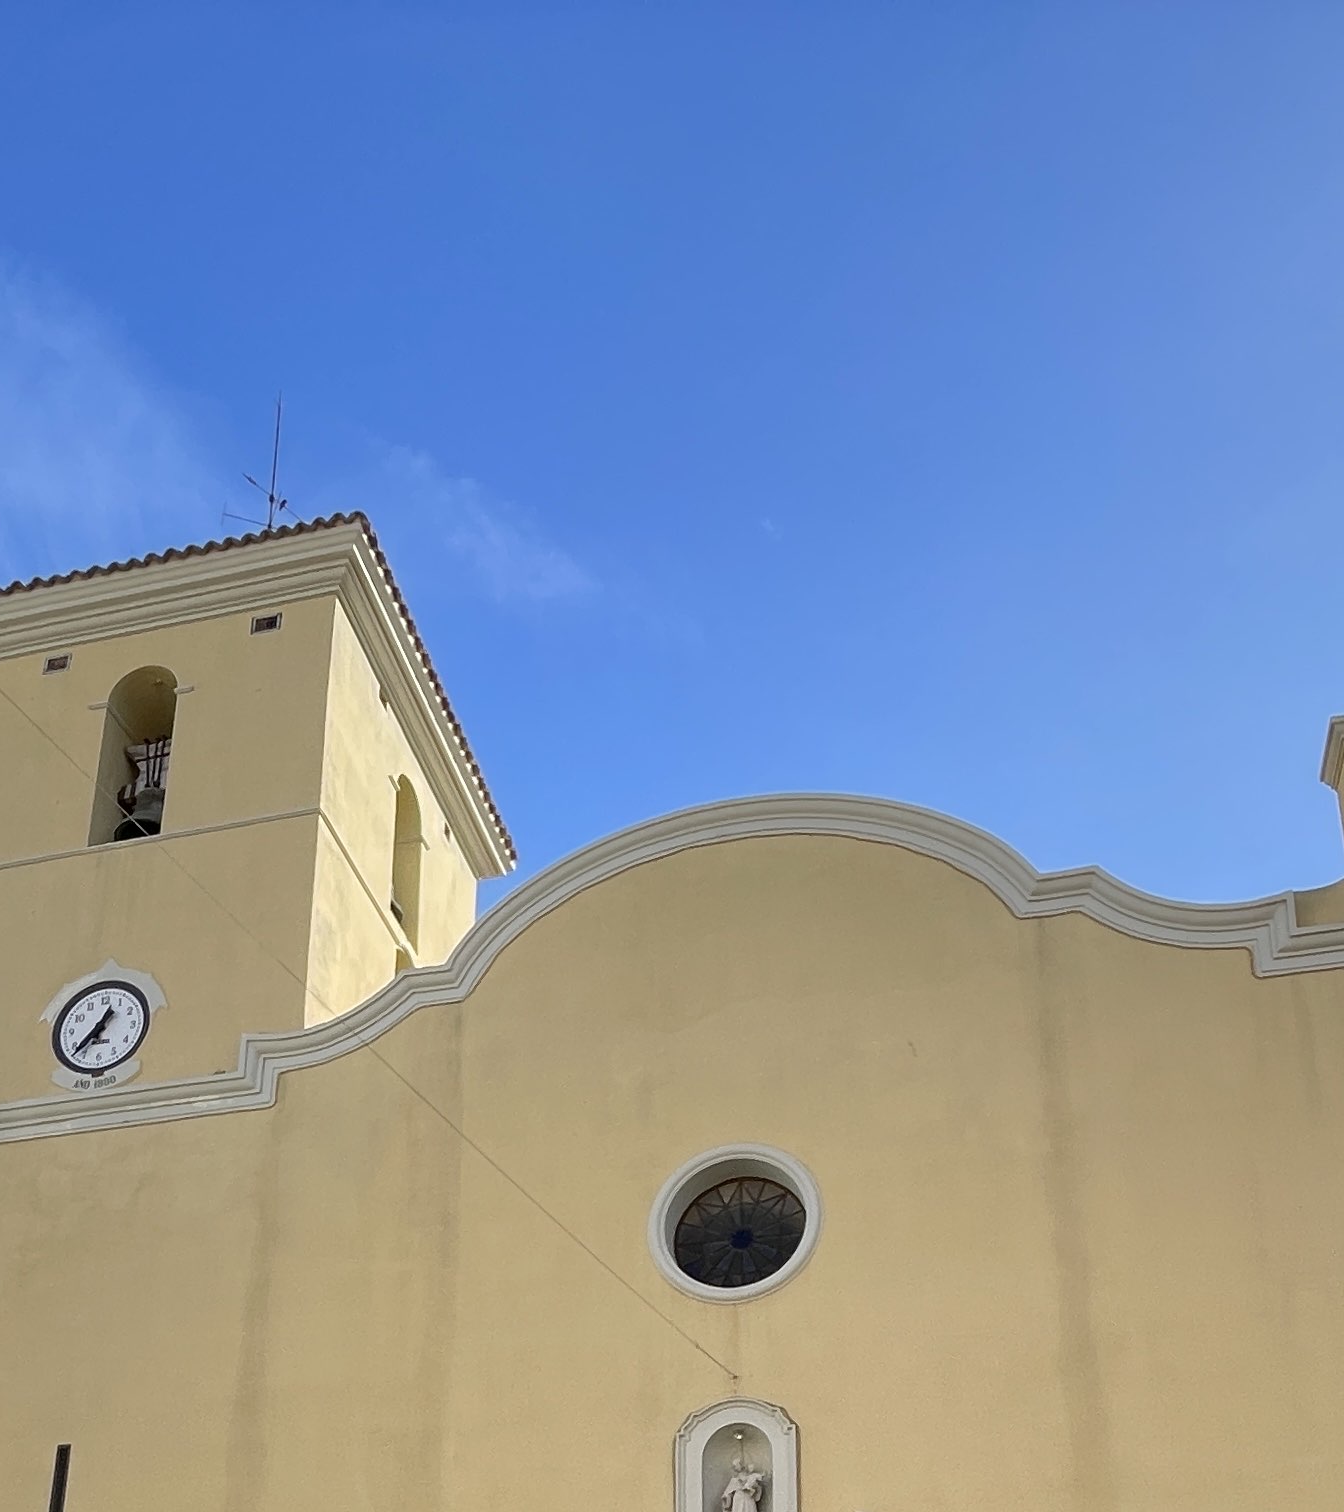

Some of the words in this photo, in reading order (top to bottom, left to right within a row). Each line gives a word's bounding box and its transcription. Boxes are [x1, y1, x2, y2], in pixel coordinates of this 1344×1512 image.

[101, 996, 111, 1006] 12
[118, 998, 123, 1006] 1
[87, 1002, 95, 1011] 11
[127, 1006, 134, 1016] 2
[74, 1014, 85, 1023] 10
[130, 1020, 136, 1030] 3
[69, 1028, 75, 1036] 9
[123, 1034, 129, 1044] 4
[111, 1046, 117, 1056] 5
[96, 1052, 103, 1061] 6
[94, 1075, 116, 1088] 1800
